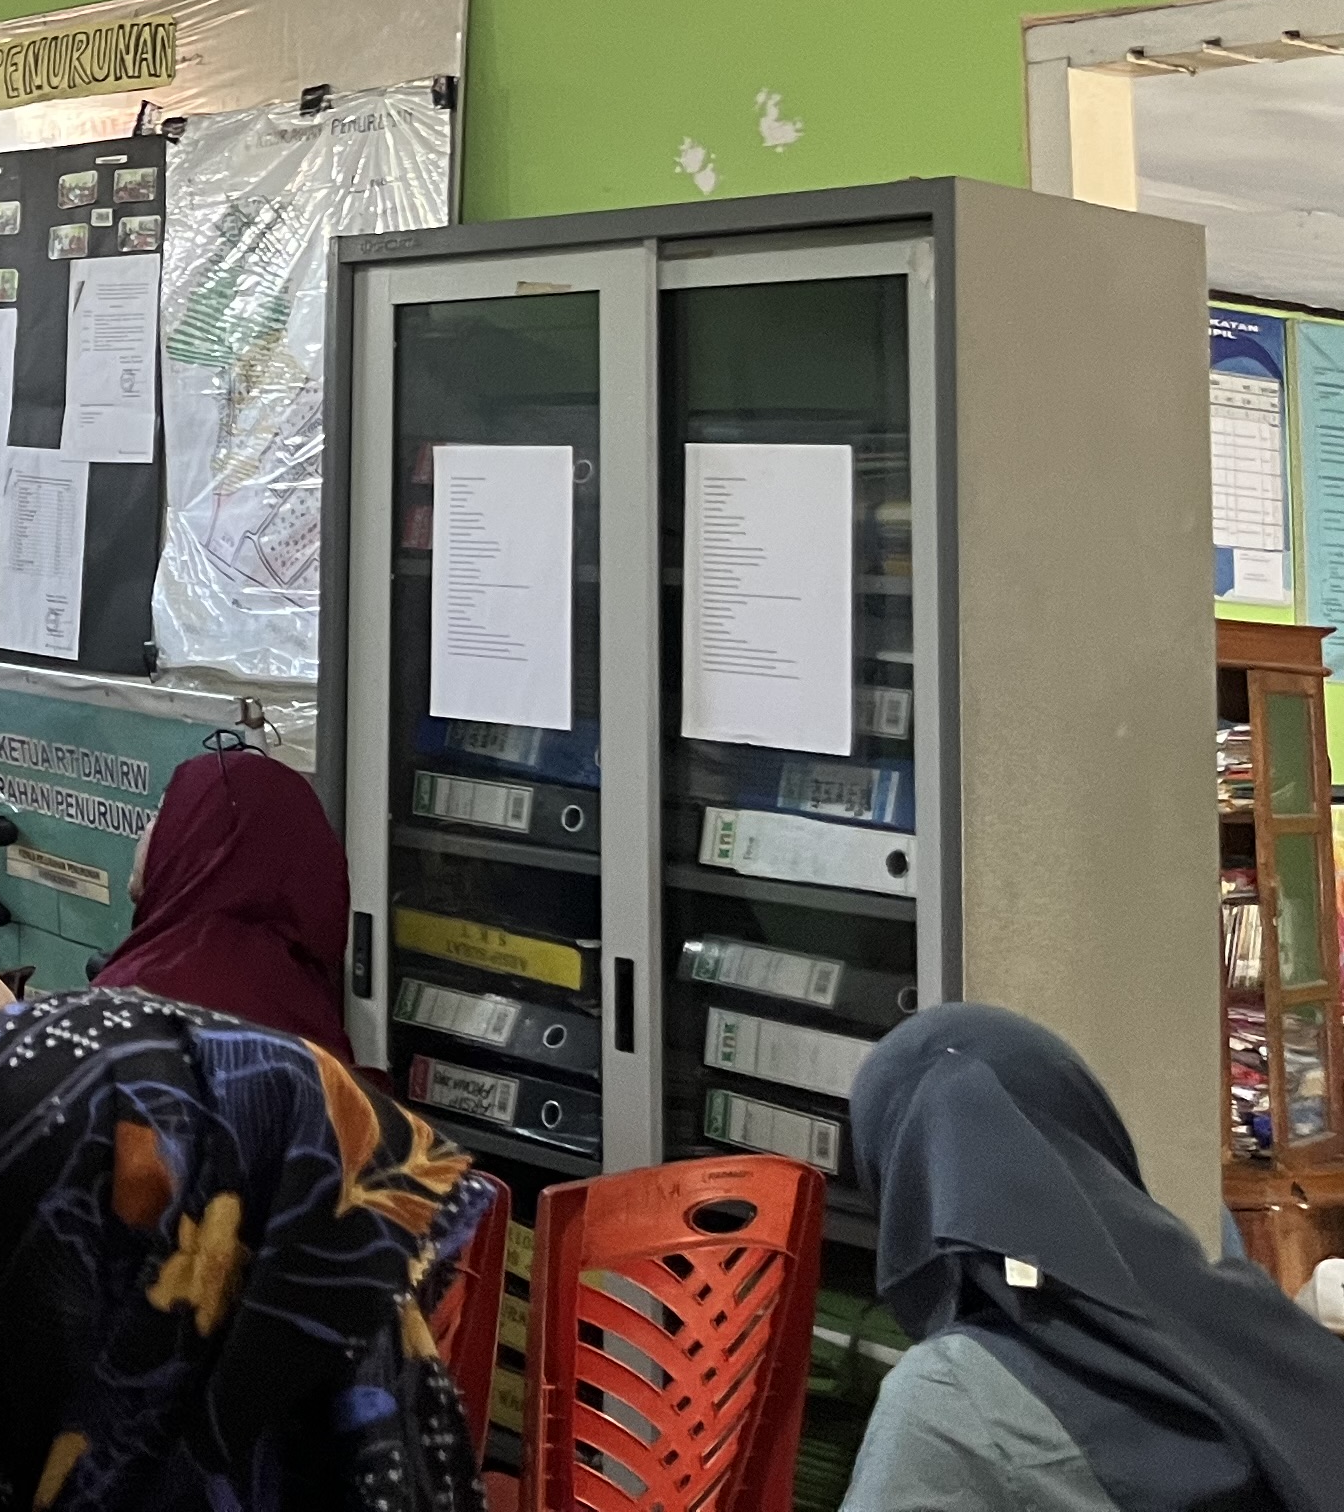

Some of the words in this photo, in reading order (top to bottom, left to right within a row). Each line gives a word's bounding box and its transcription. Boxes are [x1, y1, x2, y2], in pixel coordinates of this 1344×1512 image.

[54, 744, 80, 772] RT
[80, 750, 115, 785] DAN
[120, 759, 149, 792] RW
